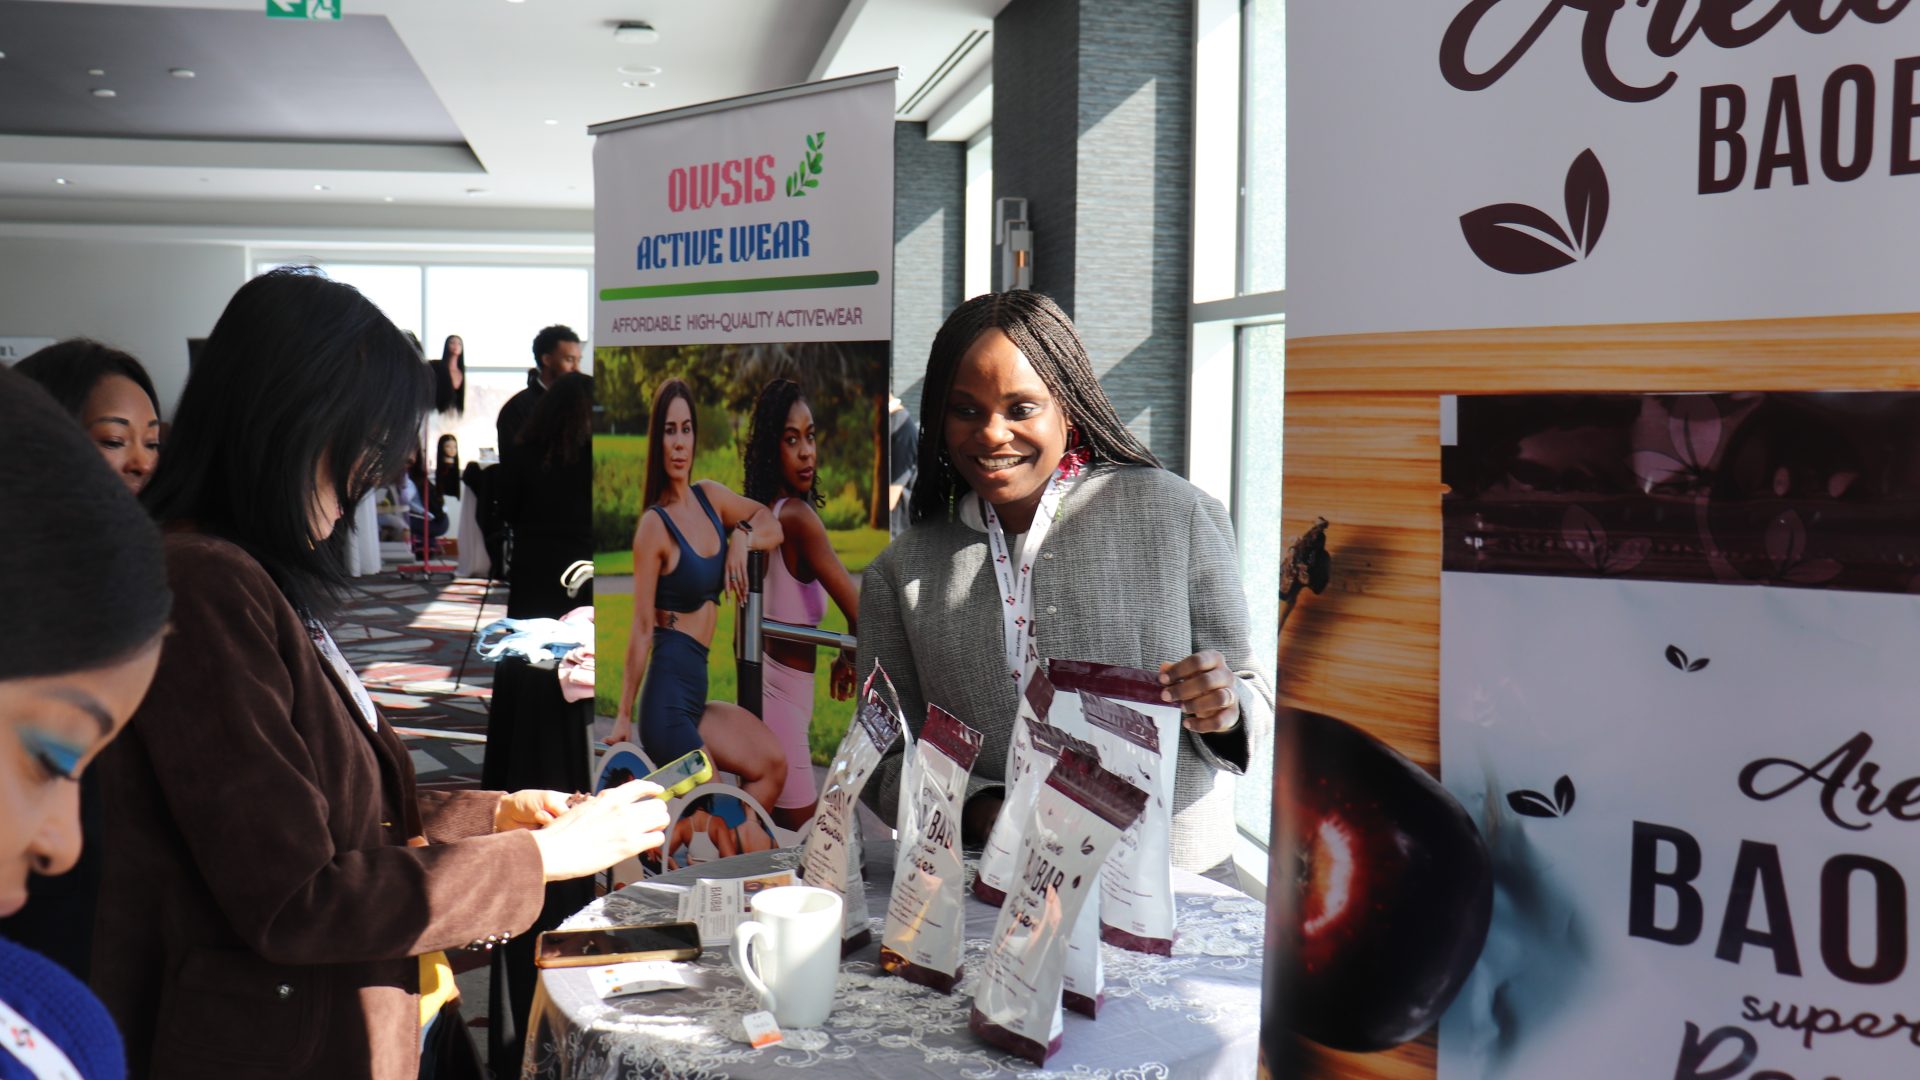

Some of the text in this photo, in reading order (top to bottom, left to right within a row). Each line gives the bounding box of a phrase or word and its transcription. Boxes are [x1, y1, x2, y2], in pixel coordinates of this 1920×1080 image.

[668, 154, 775, 212] OWSIS
[637, 219, 810, 270] ACTIVE WEAR
[612, 307, 863, 333] AFFORDABLE HIGH-QUALITY ACTIVEWEAR
[1628, 820, 1907, 985] BAO
